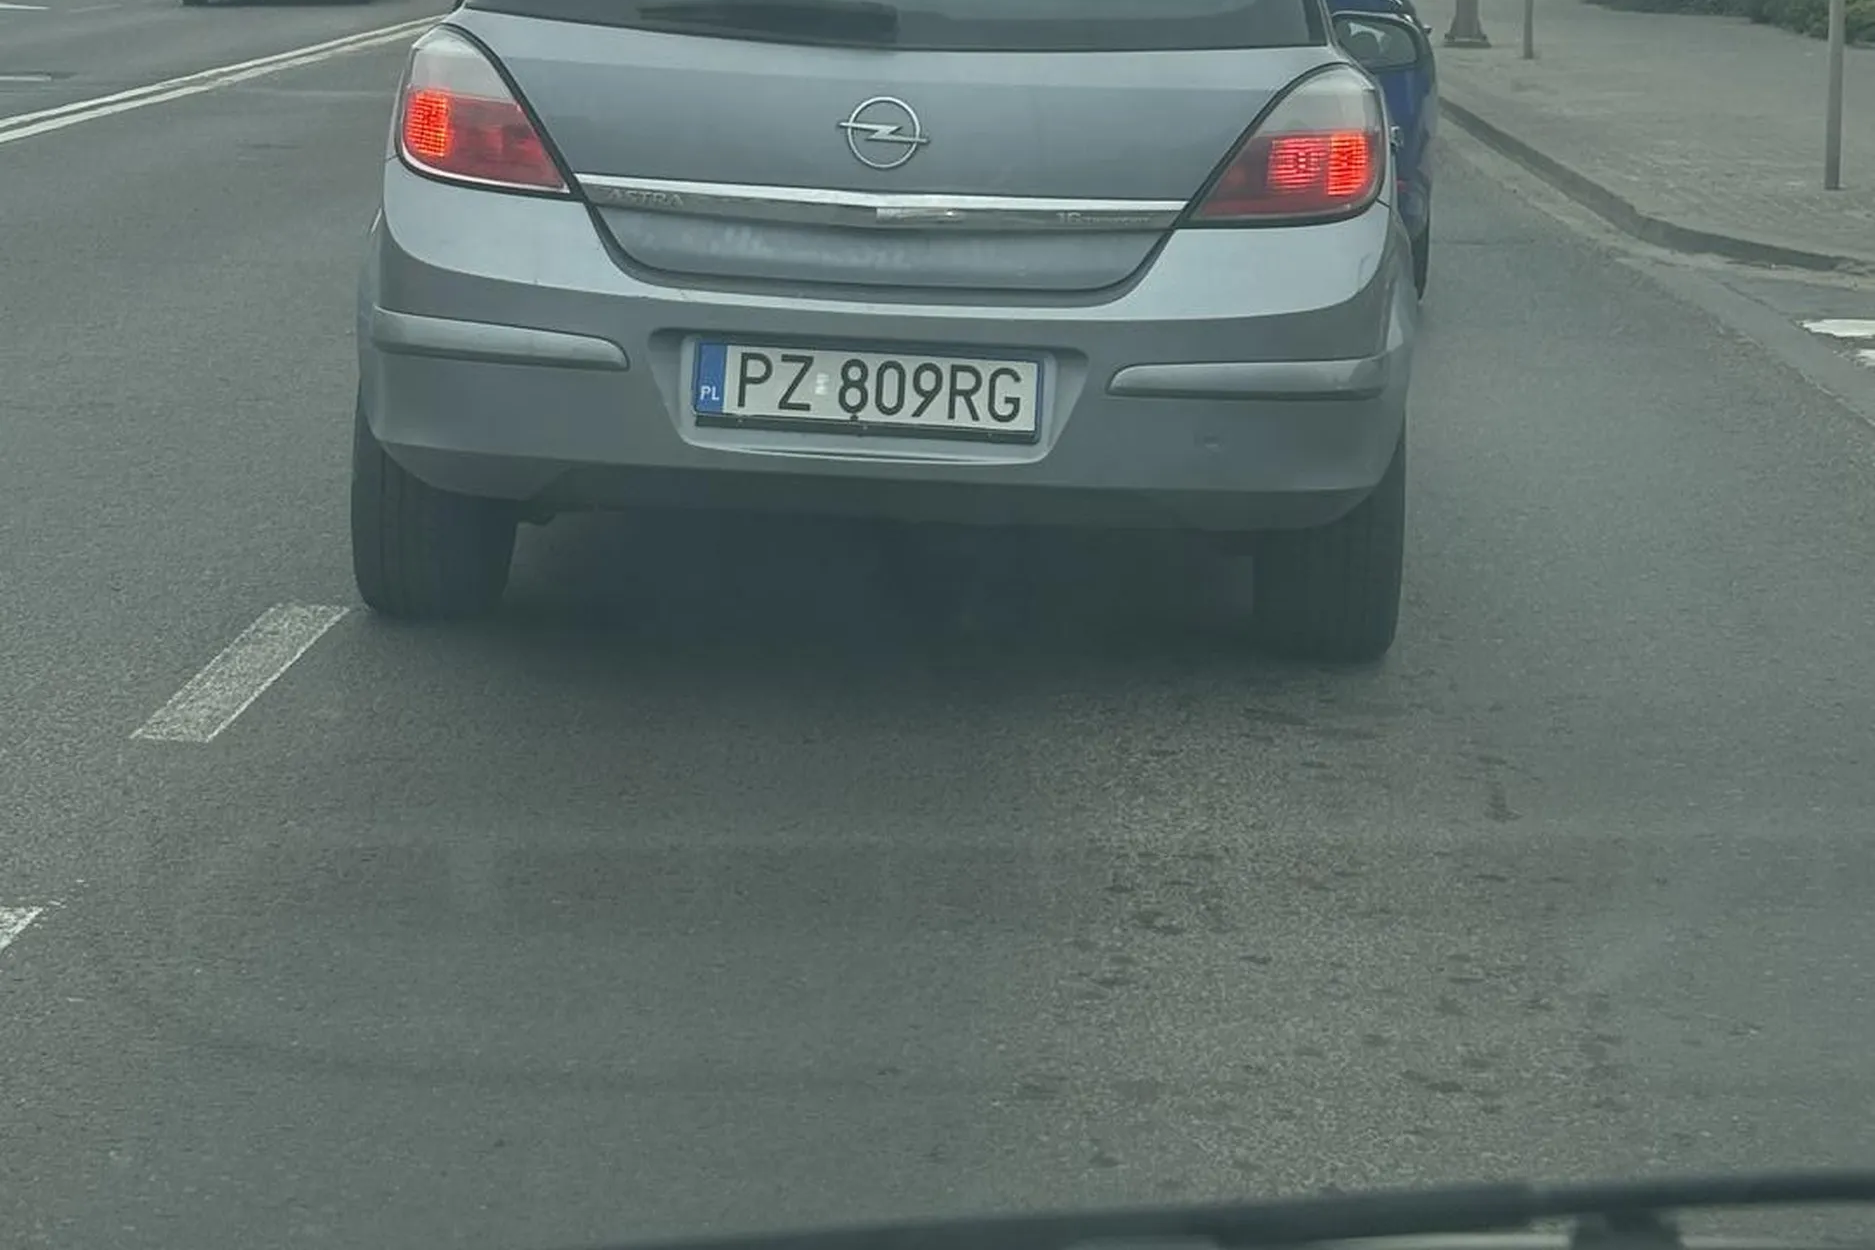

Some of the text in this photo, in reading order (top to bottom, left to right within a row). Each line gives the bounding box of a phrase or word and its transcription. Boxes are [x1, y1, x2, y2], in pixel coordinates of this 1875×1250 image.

[607, 188, 684, 207] ASTRA
[699, 385, 720, 402] PL
[736, 352, 1022, 424] PZ 809RG
